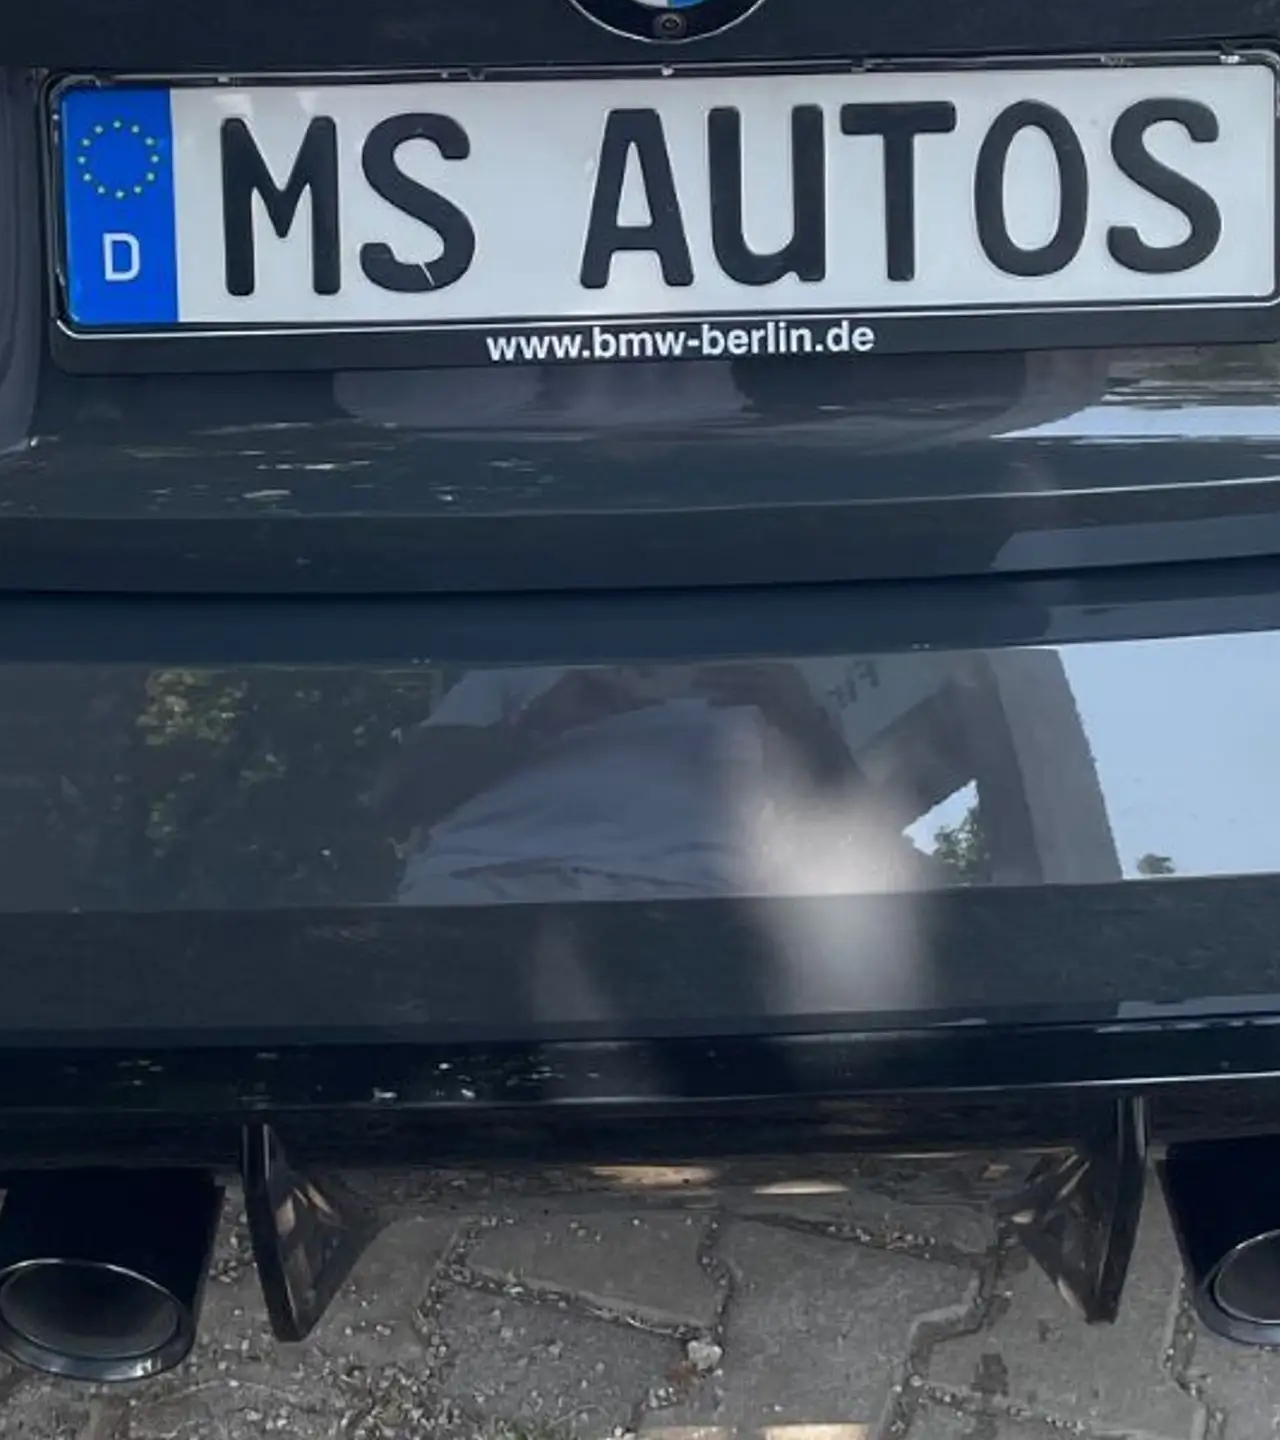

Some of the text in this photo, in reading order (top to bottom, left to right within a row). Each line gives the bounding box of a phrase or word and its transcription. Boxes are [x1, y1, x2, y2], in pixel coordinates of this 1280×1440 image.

[219, 97, 1223, 297] MS AUTOS
[102, 232, 140, 282] D
[486, 320, 876, 362] www.bmw-berlin.de
